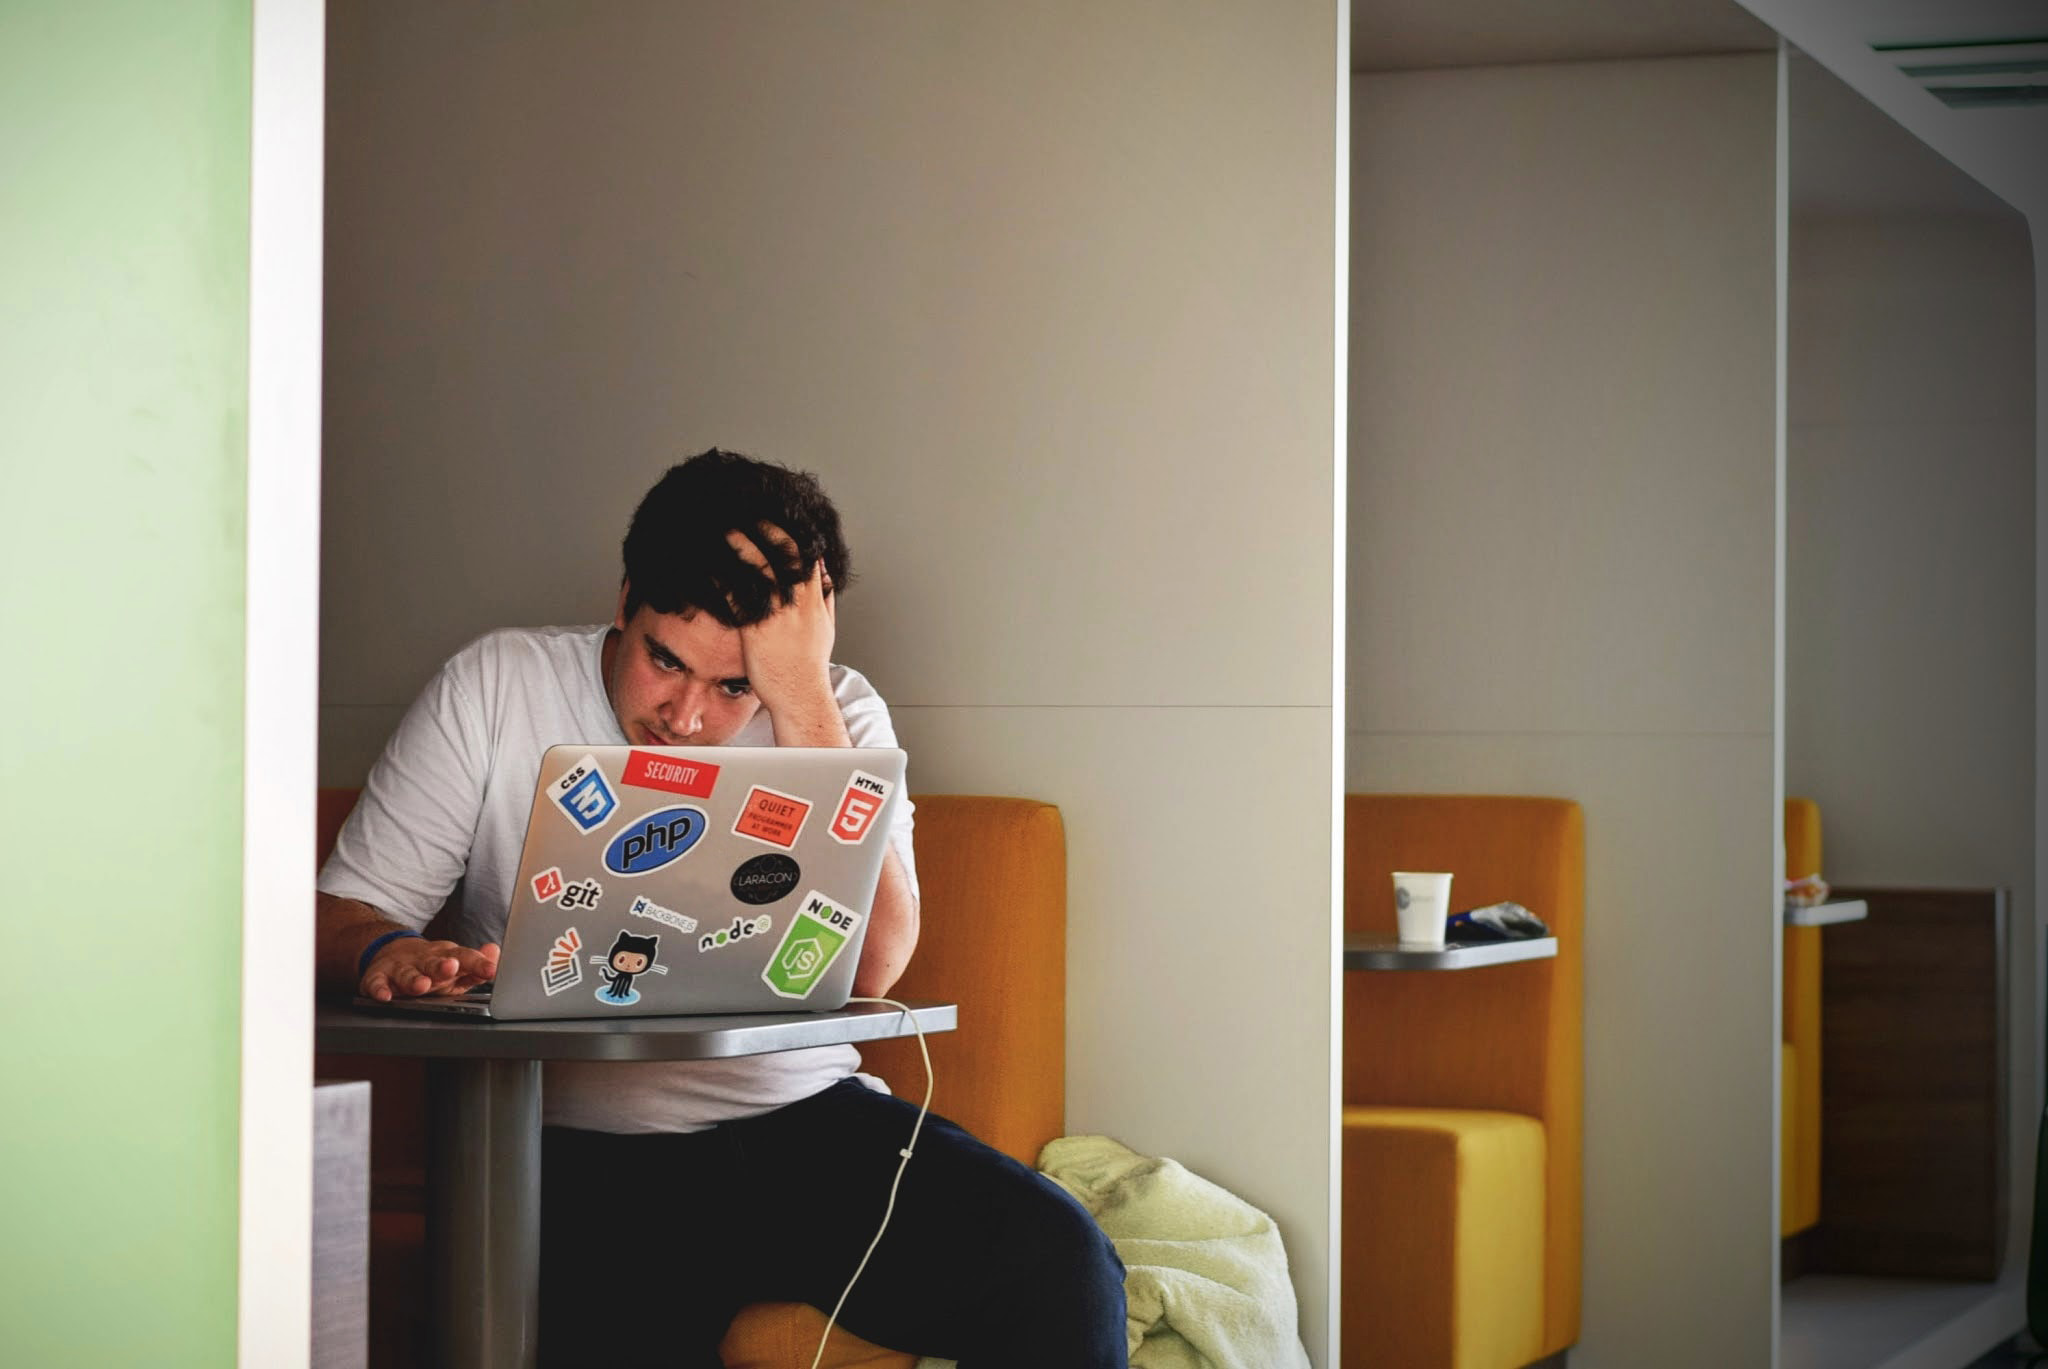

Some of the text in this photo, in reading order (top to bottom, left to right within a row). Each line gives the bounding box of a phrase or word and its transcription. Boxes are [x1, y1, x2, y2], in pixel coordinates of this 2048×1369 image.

[560, 767, 586, 790] CSS
[644, 760, 700, 786] SECURITY
[855, 776, 885, 795] HTML
[759, 799, 796, 817] QUIET
[840, 798, 874, 832] 5
[748, 812, 793, 831] PROGRAMMER
[762, 826, 782, 837] WORK
[622, 816, 692, 870] php
[738, 872, 793, 887] LARACON
[560, 882, 600, 907] git
[808, 898, 853, 931] NODE
